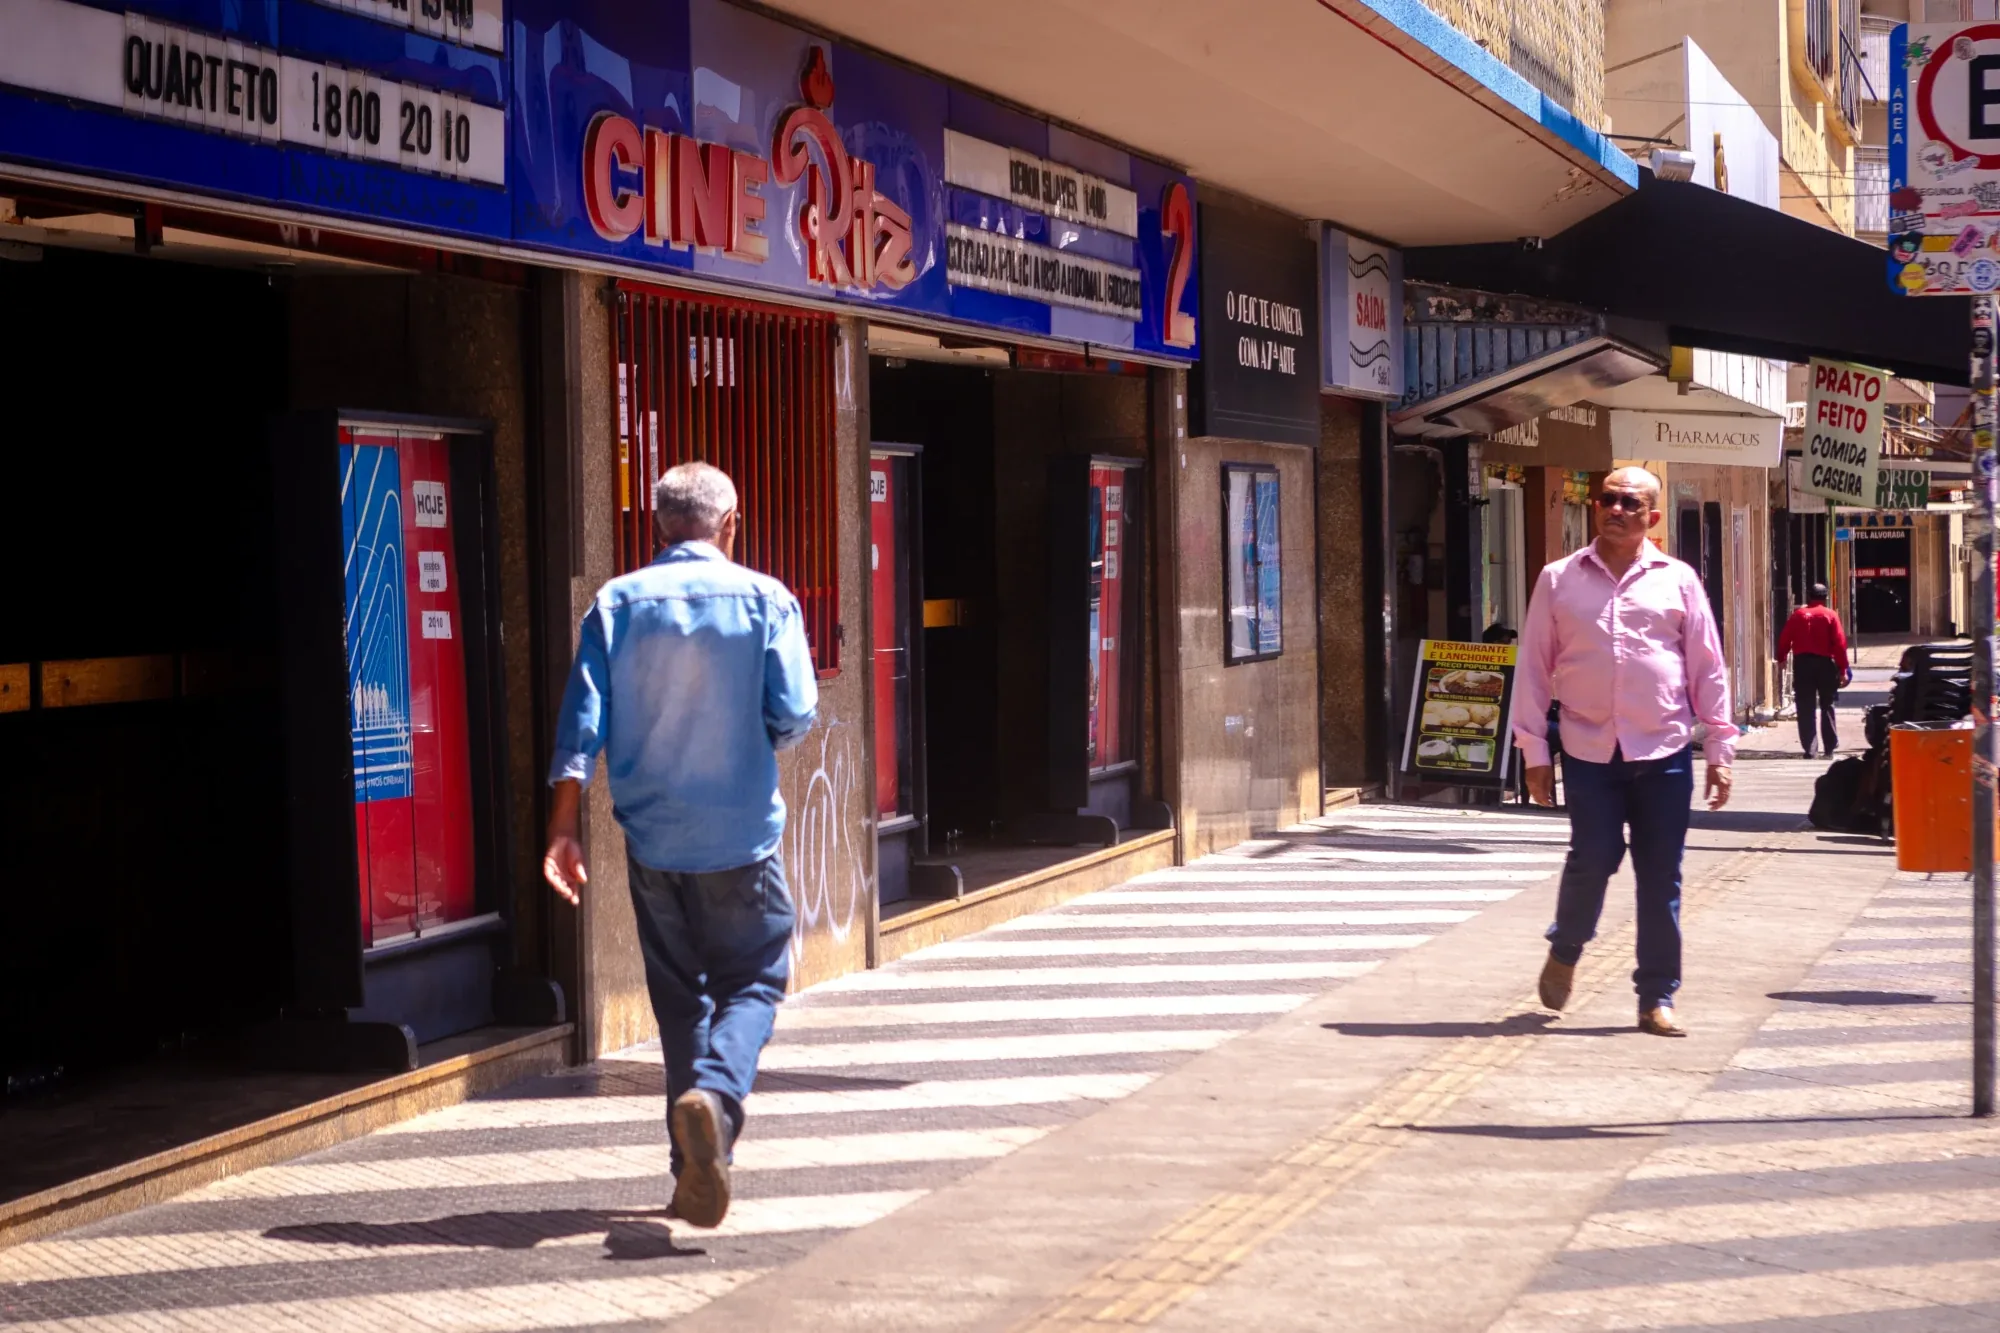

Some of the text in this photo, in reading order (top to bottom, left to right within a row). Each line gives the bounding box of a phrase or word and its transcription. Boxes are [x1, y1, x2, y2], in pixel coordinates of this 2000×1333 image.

[125, 36, 278, 125] QUARTETO
[312, 71, 381, 145] 1800
[584, 111, 769, 265] CINE
[1042, 171, 1078, 212] SLAYER
[1160, 181, 1197, 348] 2
[1226, 290, 1235, 321] O
[1258, 299, 1270, 329] TE
[1271, 302, 1304, 337] CONECTA
[1356, 288, 1387, 332] SAÍDA
[1238, 336, 1259, 369] COM
[1278, 344, 1296, 375] ARTE
[1815, 364, 1881, 402] PRATO
[1656, 421, 1760, 447] PHARMACUS
[1817, 400, 1868, 434] FEITO
[1810, 434, 1867, 468] COMIDA
[1812, 464, 1862, 497] CASEIRA
[417, 493, 443, 515] HOJE
[1869, 531, 1906, 539] ALVORADA
[428, 616, 443, 628] 2010
[1430, 651, 1508, 663] E LANCHONETE
[1433, 641, 1509, 654] RESTAURANTE
[1436, 661, 1500, 671] PREÇO POPULAR
